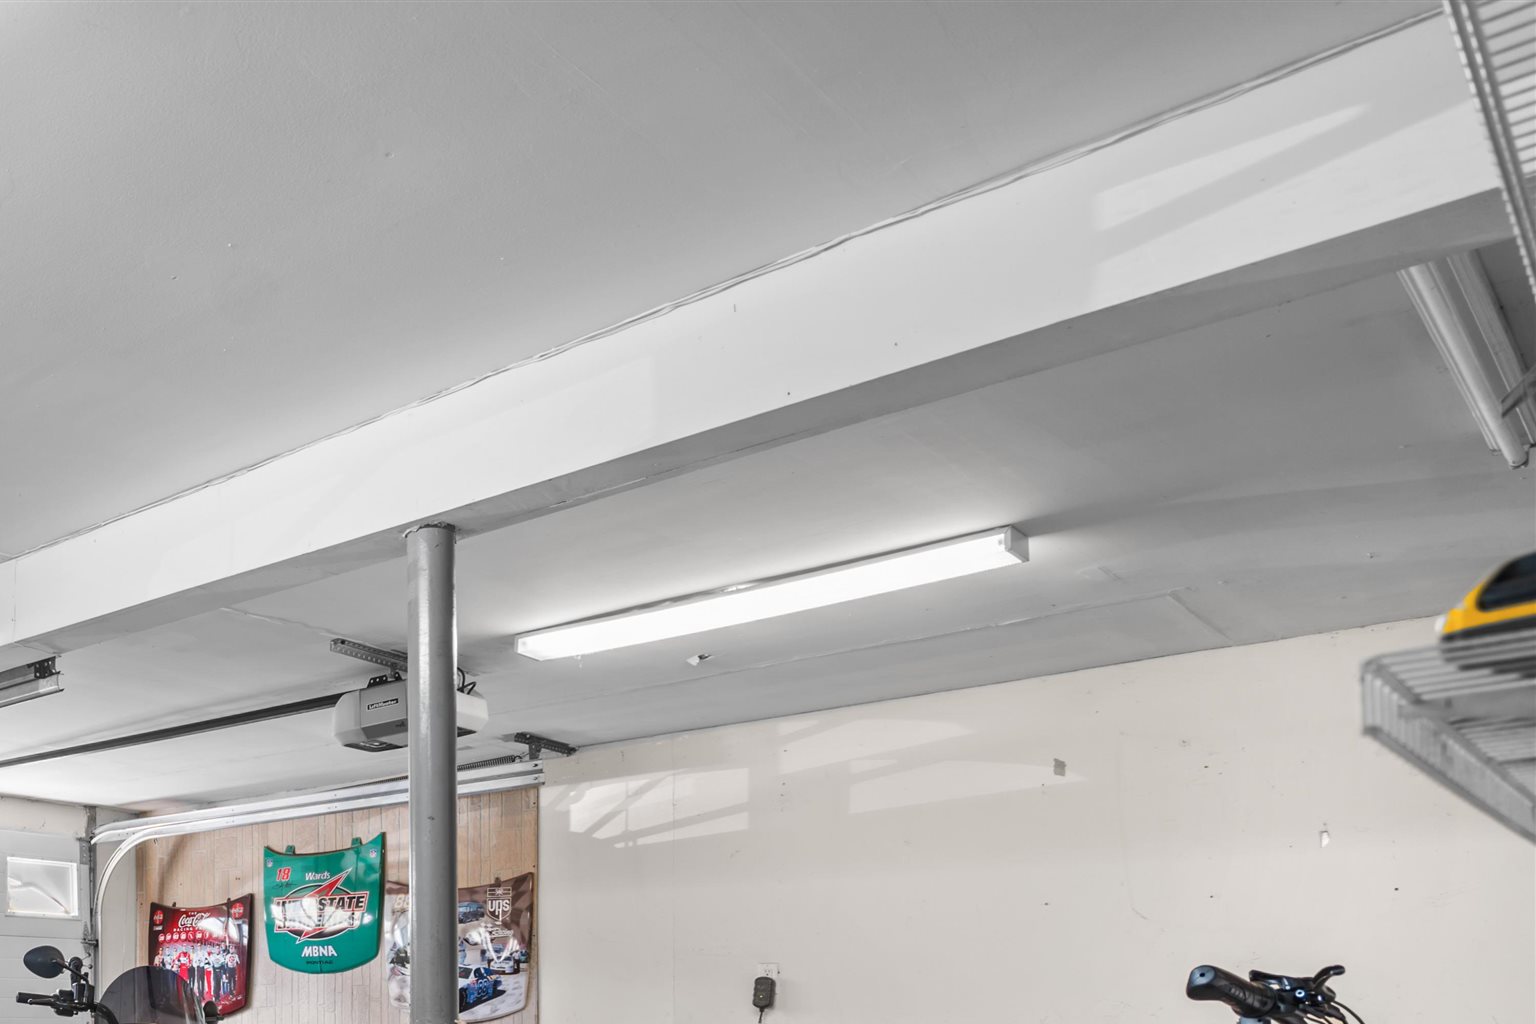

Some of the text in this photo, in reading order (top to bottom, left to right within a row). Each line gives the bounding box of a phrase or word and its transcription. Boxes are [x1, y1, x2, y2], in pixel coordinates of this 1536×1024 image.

[276, 867, 291, 882] 18
[305, 871, 331, 880] Wards
[301, 945, 338, 957] MBNA
